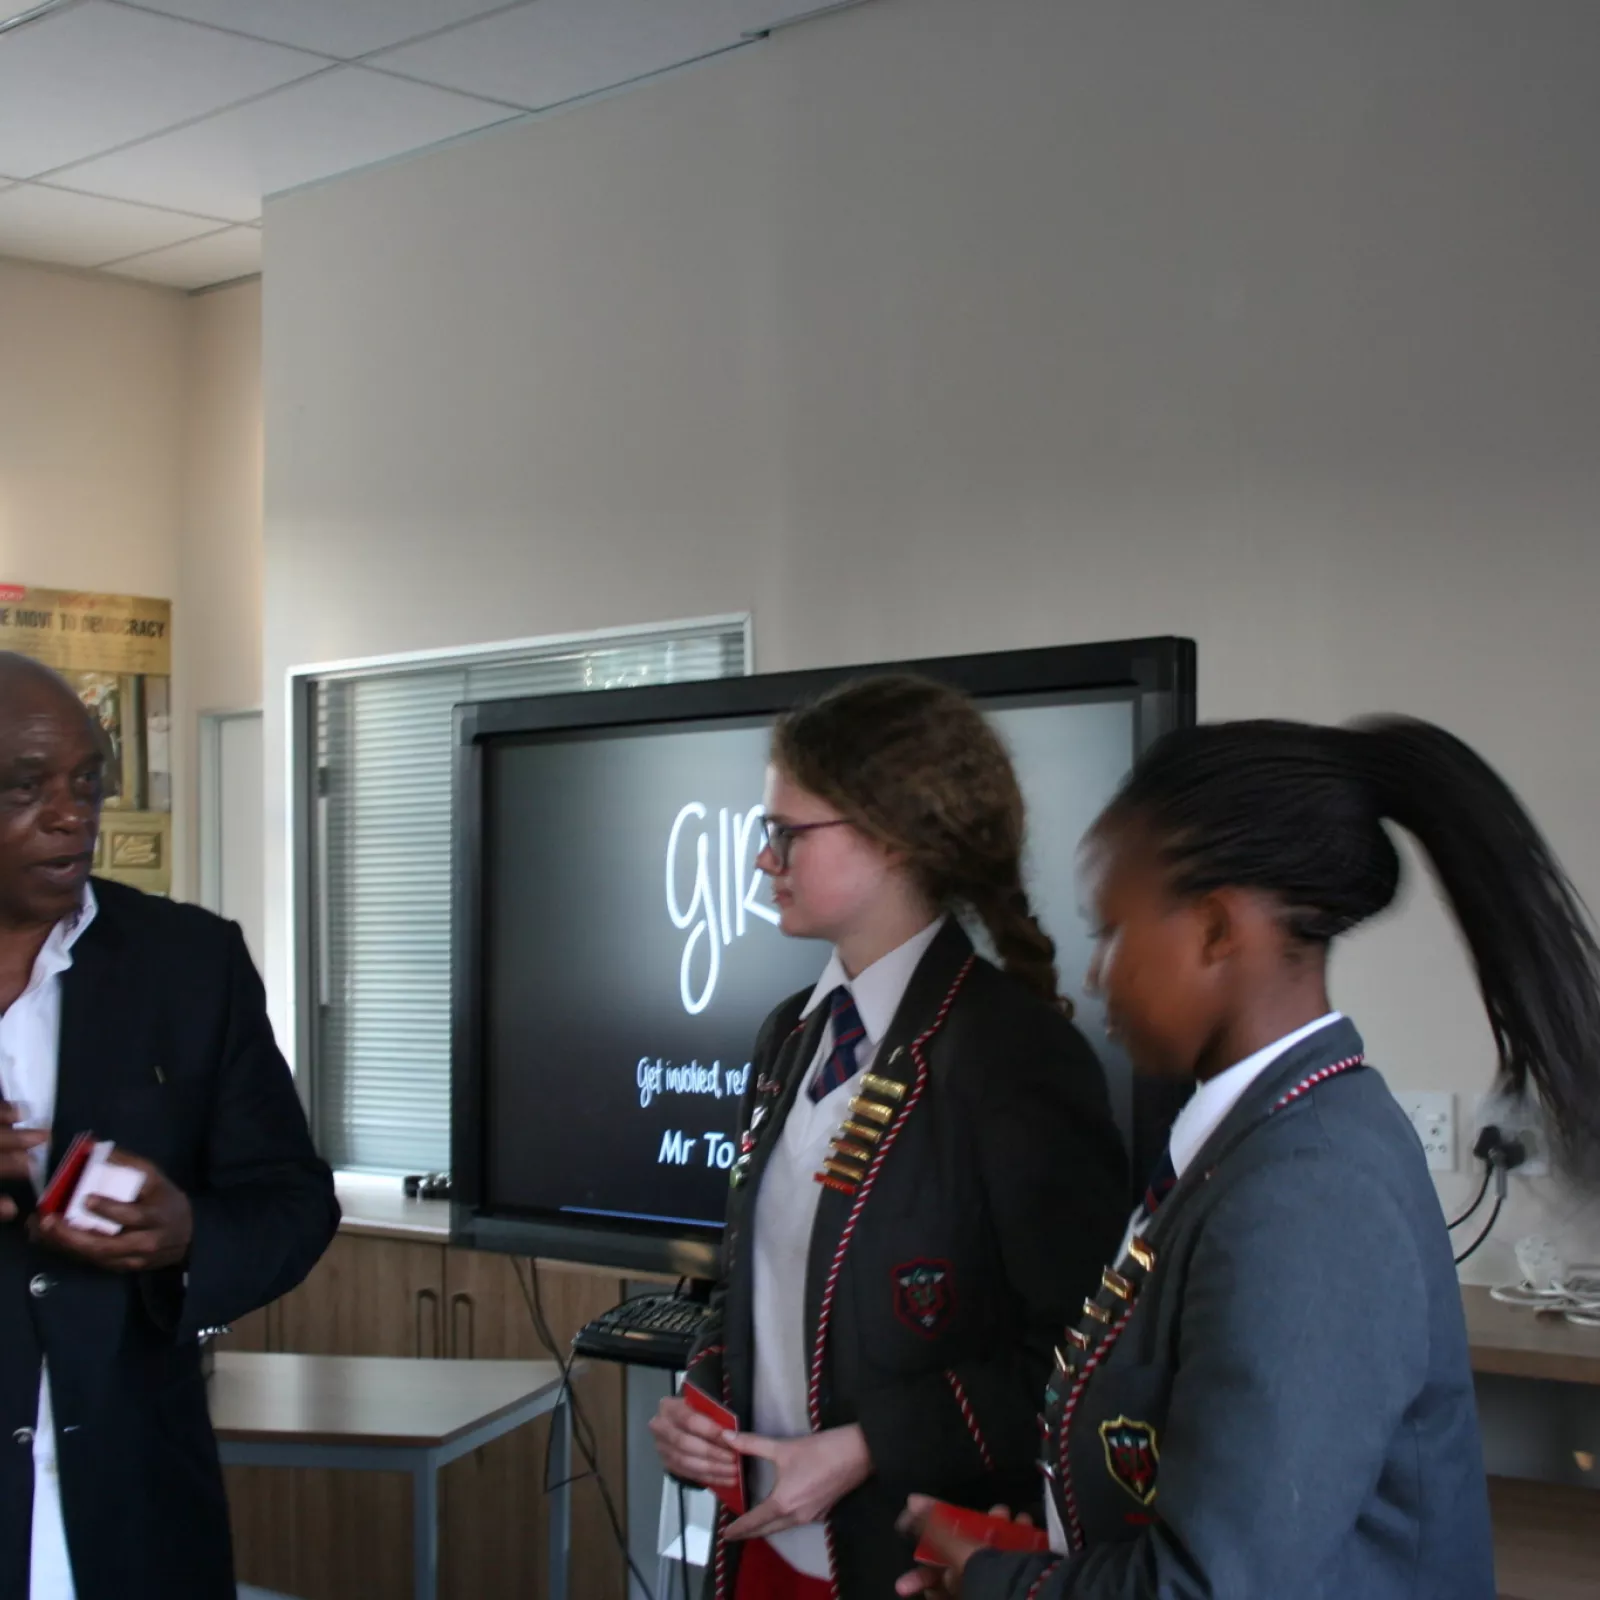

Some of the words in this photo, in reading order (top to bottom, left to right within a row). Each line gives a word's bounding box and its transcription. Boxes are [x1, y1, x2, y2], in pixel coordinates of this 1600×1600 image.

[81, 615, 166, 639] DERACY
[636, 1056, 664, 1109] Get
[657, 1128, 697, 1166] Mr
[703, 1131, 736, 1169] To
